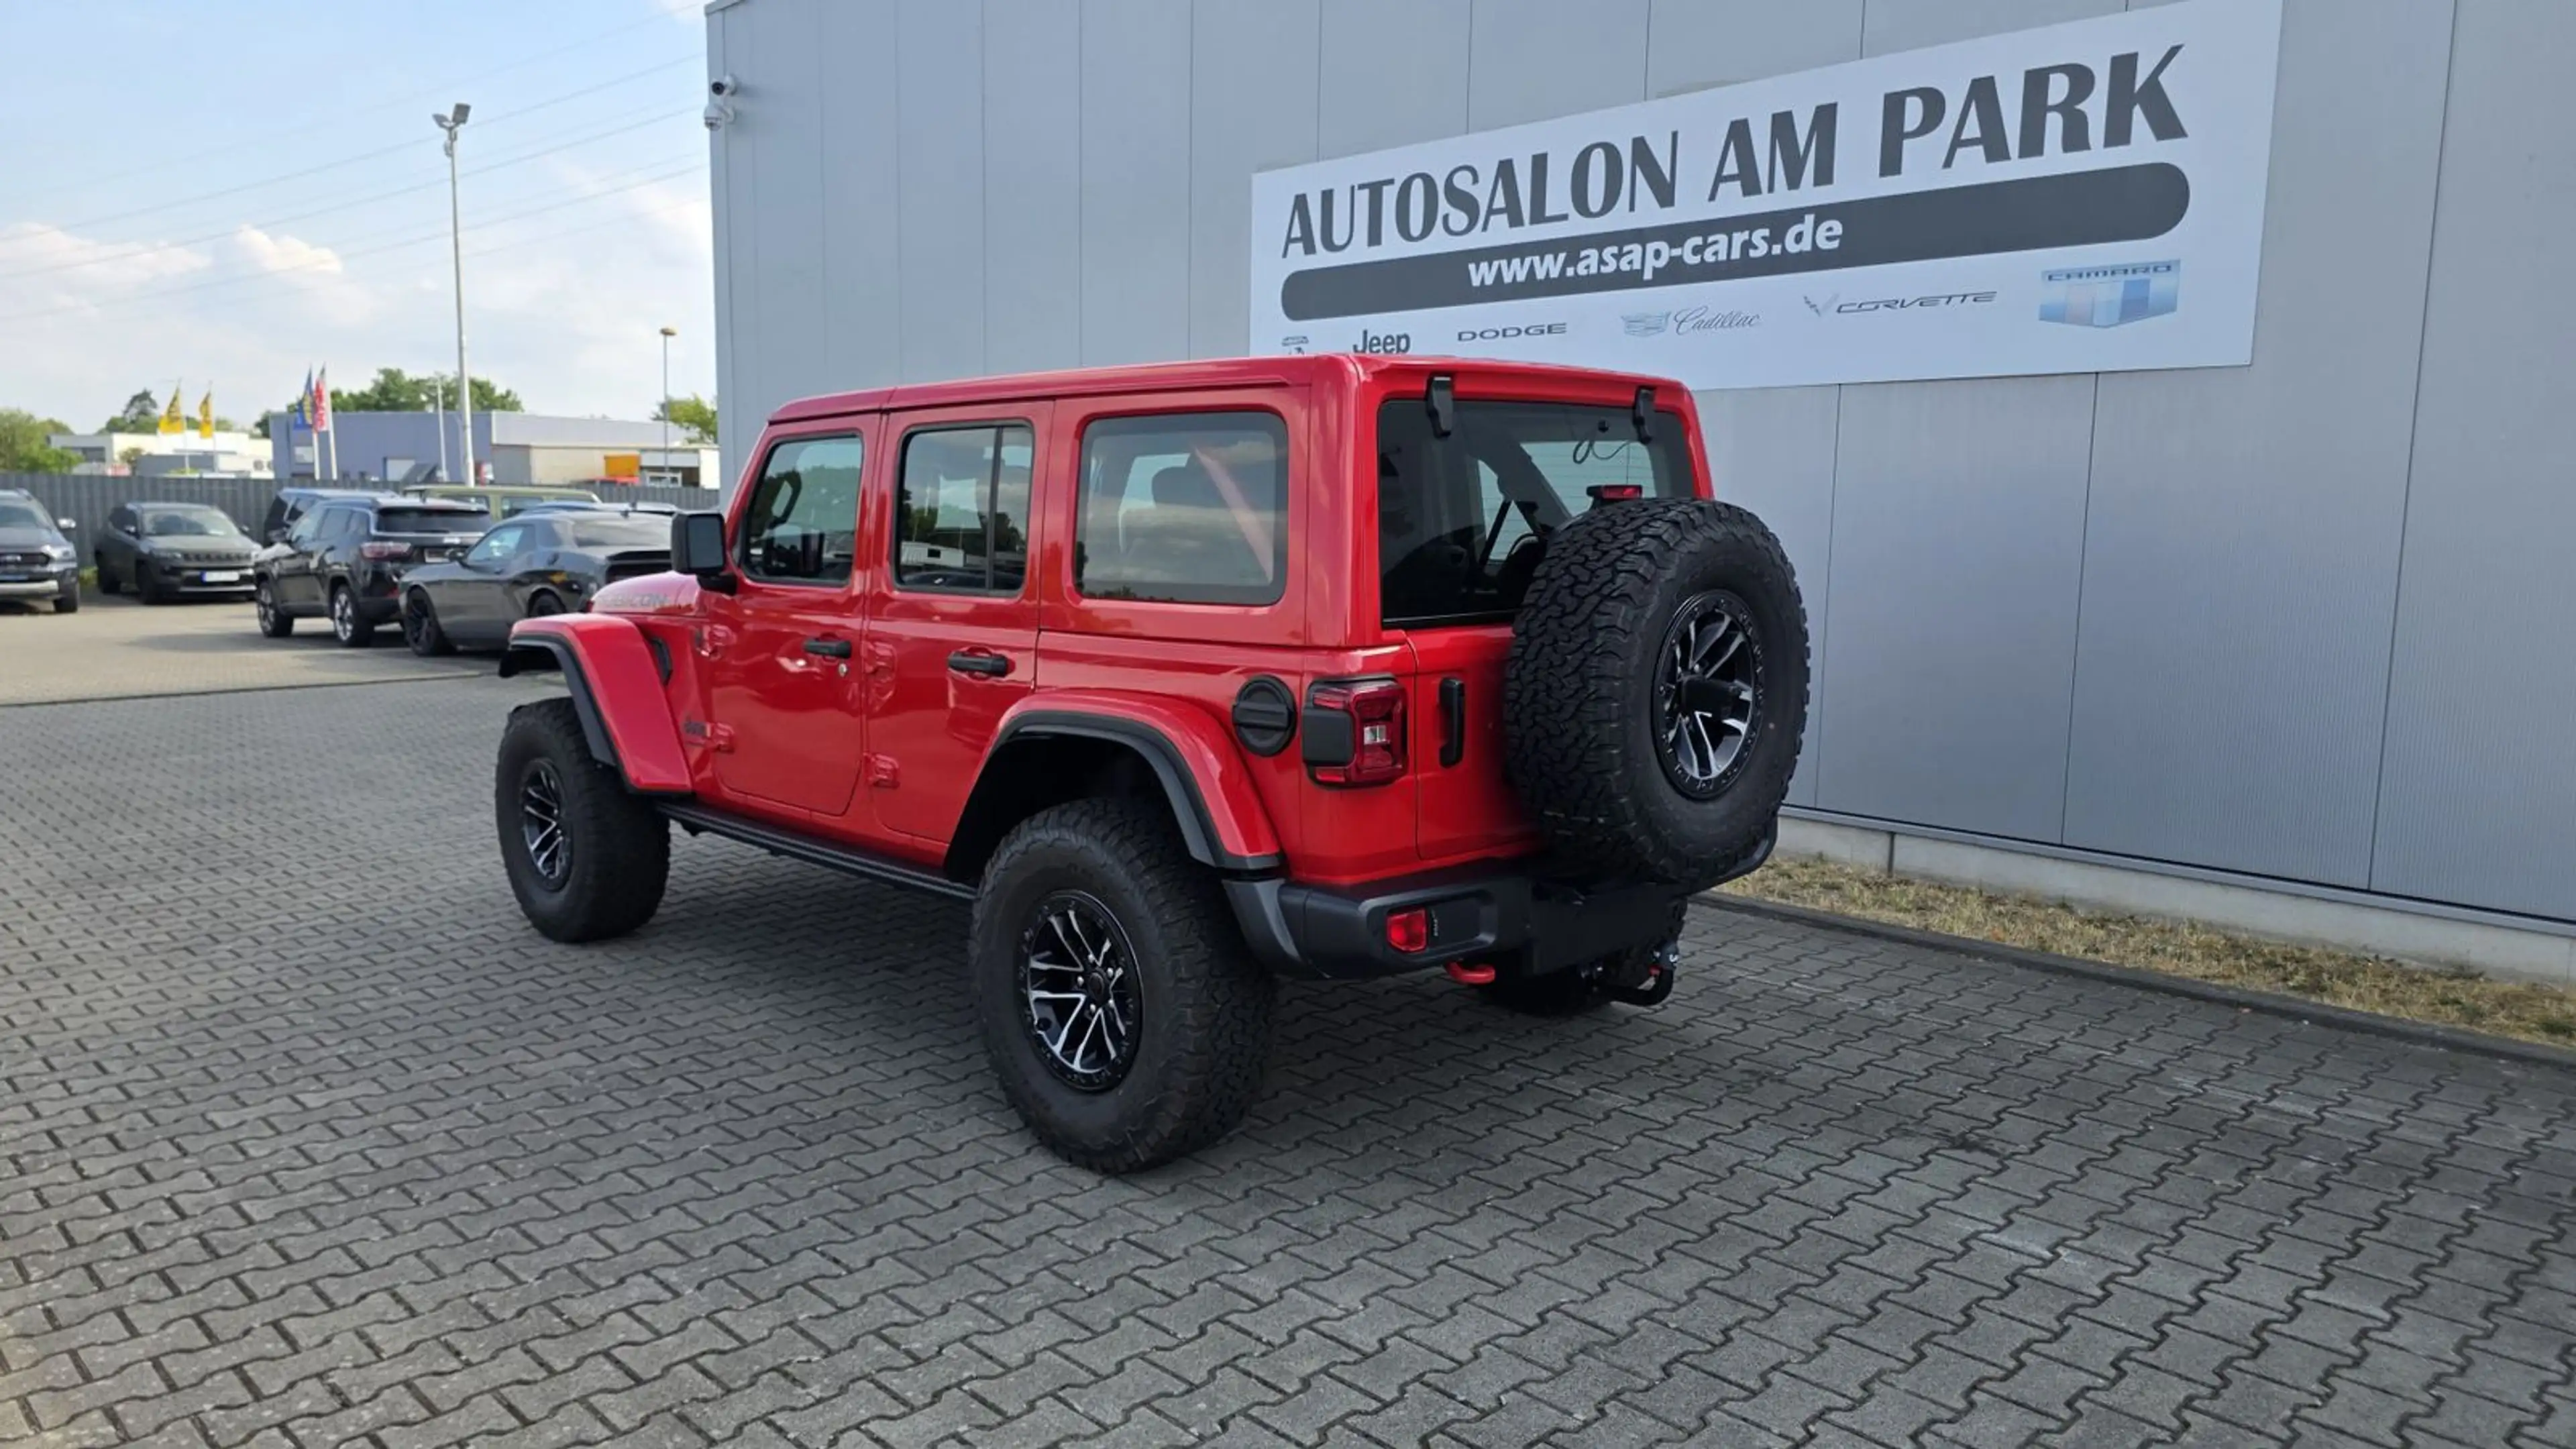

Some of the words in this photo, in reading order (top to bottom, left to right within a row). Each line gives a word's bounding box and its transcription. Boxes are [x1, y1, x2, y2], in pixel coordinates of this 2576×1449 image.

[1282, 130, 1678, 258] AUTOSALON
[1708, 101, 1838, 202] AM
[1878, 44, 2188, 178] PARK
[1468, 214, 1843, 287] www.asap-cars.de
[1352, 329, 1411, 354] Jeep
[1458, 323, 1567, 341] DODGE
[1674, 305, 1762, 335] Cadillac
[1836, 291, 1998, 314] CORVETTE
[2047, 264, 2172, 282] CAMARO
